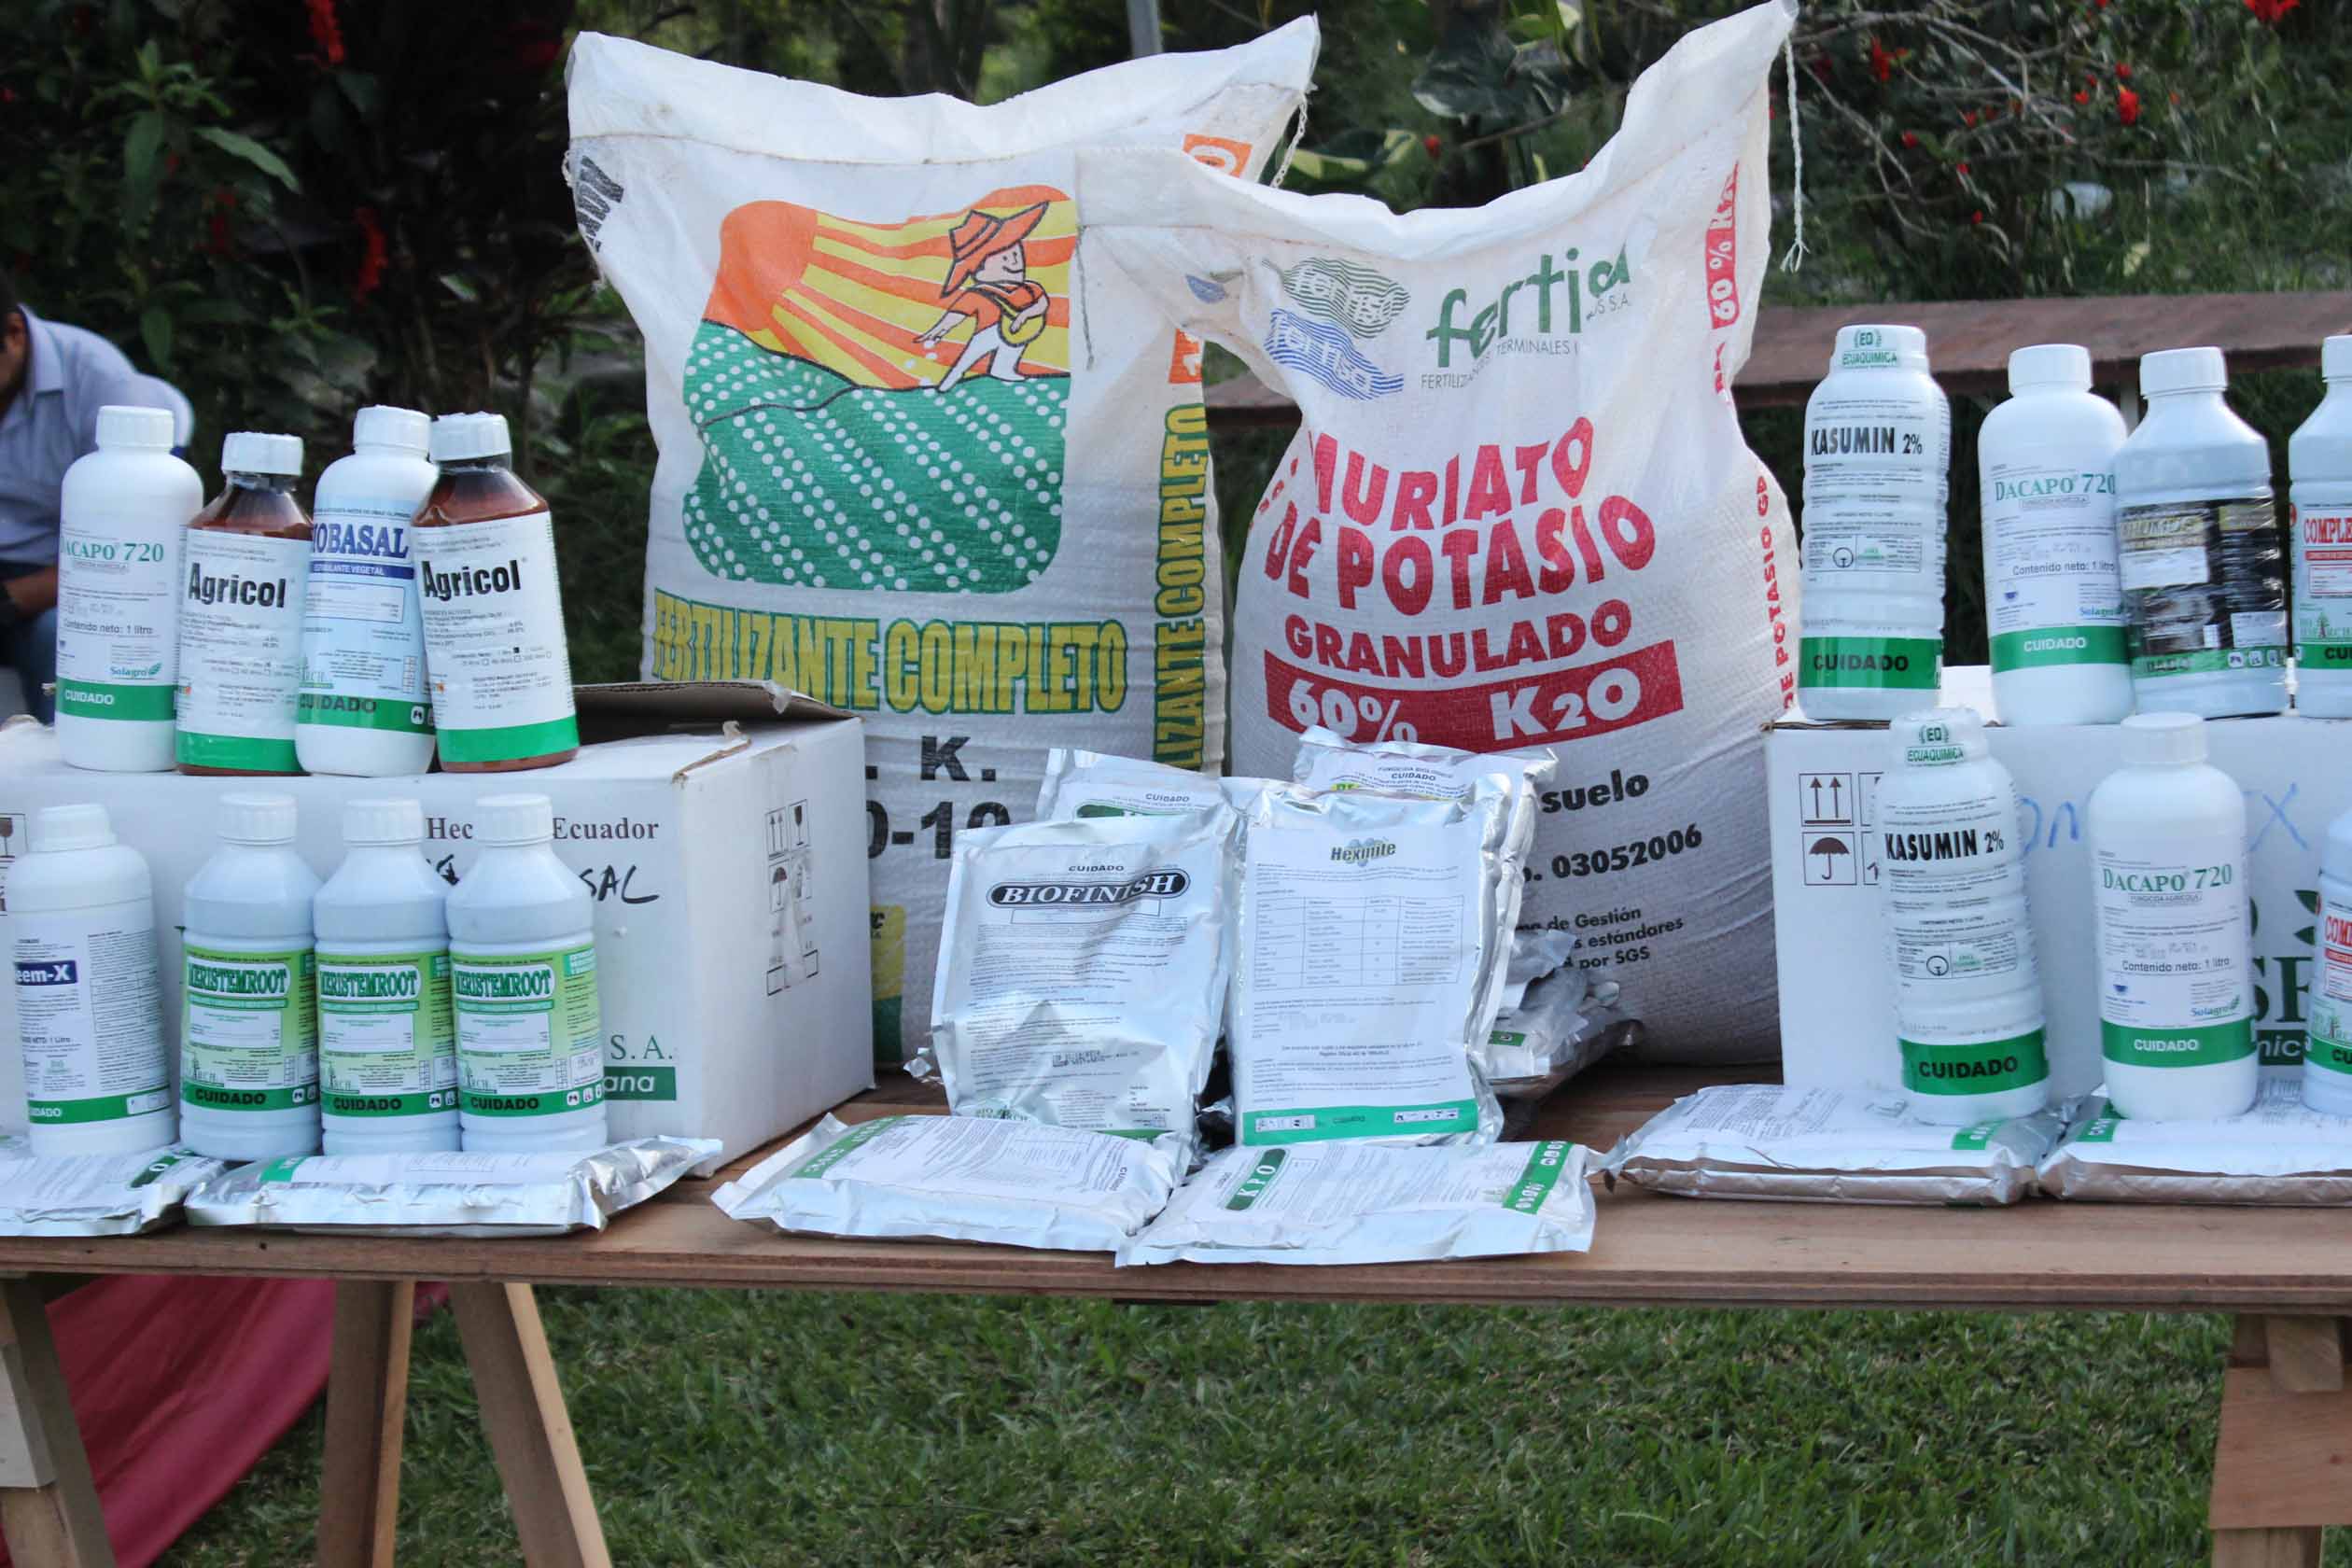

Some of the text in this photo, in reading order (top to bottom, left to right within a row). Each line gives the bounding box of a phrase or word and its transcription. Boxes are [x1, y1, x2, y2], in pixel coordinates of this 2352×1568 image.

[1497, 338, 1569, 357] TERMINALES
[1811, 427, 1923, 456] KASUMIN 2%
[1995, 473, 2116, 501] DACAPO 720
[1155, 403, 1210, 619] COMPLETO
[123, 542, 164, 562] 720
[1264, 495, 1656, 616] DE POTASIO
[422, 559, 522, 603] Agricol
[2012, 561, 2062, 577] Contenido
[189, 561, 287, 609] Agricol
[1285, 598, 1632, 679] GRANULADO
[2023, 637, 2087, 653] CUIDADO
[884, 618, 1127, 715] COMPLETO
[1813, 654, 1909, 671] CUIDADO
[64, 689, 115, 706] CUIDADO
[1391, 773, 1437, 782] CUIDADO
[1144, 792, 1191, 804] CUIDADO
[1541, 769, 1650, 814] suelo
[553, 817, 660, 840] Ecuador
[1551, 822, 1703, 879] 03052006
[1885, 828, 2005, 861] KASUMIN 2%
[1069, 864, 1125, 873] CUIDADO
[2103, 863, 2233, 893] DACAPO 720
[999, 873, 1180, 904] BIOFINISH
[1575, 905, 1642, 930] Gestión
[1588, 917, 1685, 948] estándares
[1579, 945, 1651, 971] por SGS
[2121, 959, 2172, 973] Contenido
[2175, 959, 2202, 973] neto:
[2212, 957, 2230, 968] litro
[2134, 1038, 2200, 1053] CUIDADO
[1918, 1056, 2019, 1080] CUIDADO
[194, 1088, 268, 1105] CUIDADO
[332, 1097, 402, 1112] CUIDADO
[469, 1097, 539, 1111] CUIDADO
